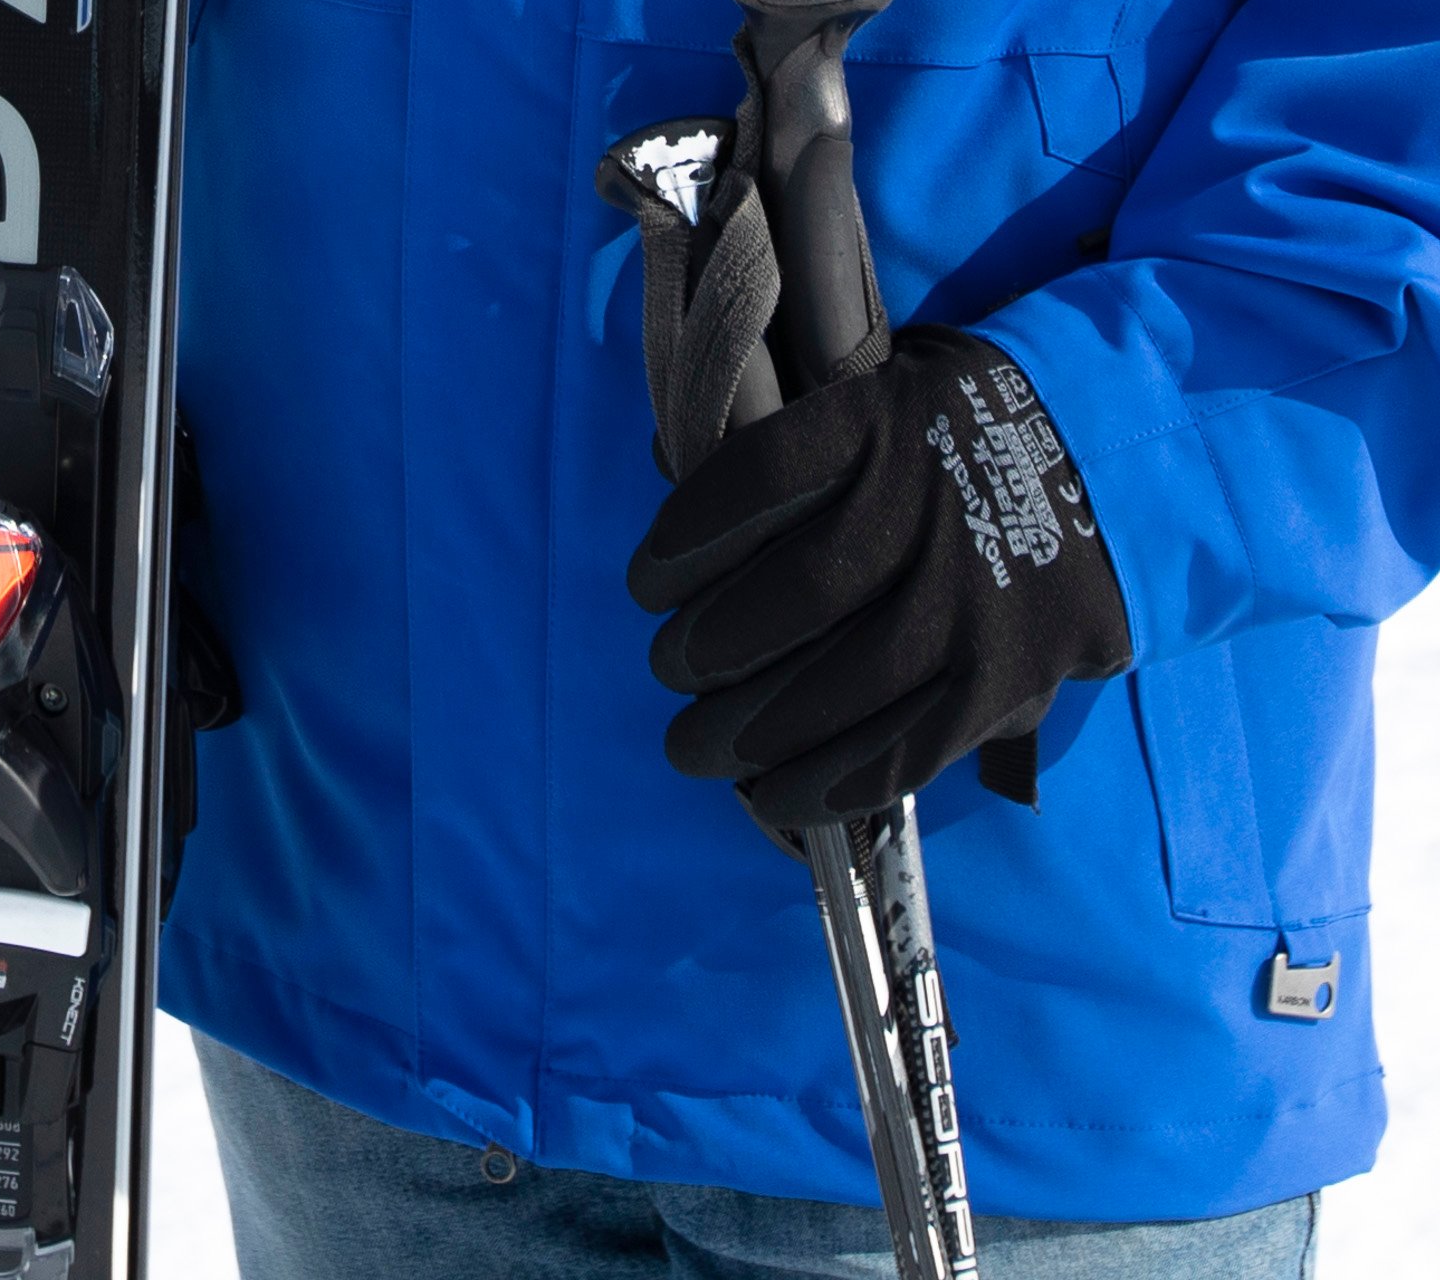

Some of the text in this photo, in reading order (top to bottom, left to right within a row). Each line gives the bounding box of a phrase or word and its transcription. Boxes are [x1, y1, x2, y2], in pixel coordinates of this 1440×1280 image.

[958, 374, 1038, 529] Knight
[971, 436, 1031, 557] Black
[60, 976, 86, 1046] KONECT
[914, 969, 979, 1280] SCORPI
